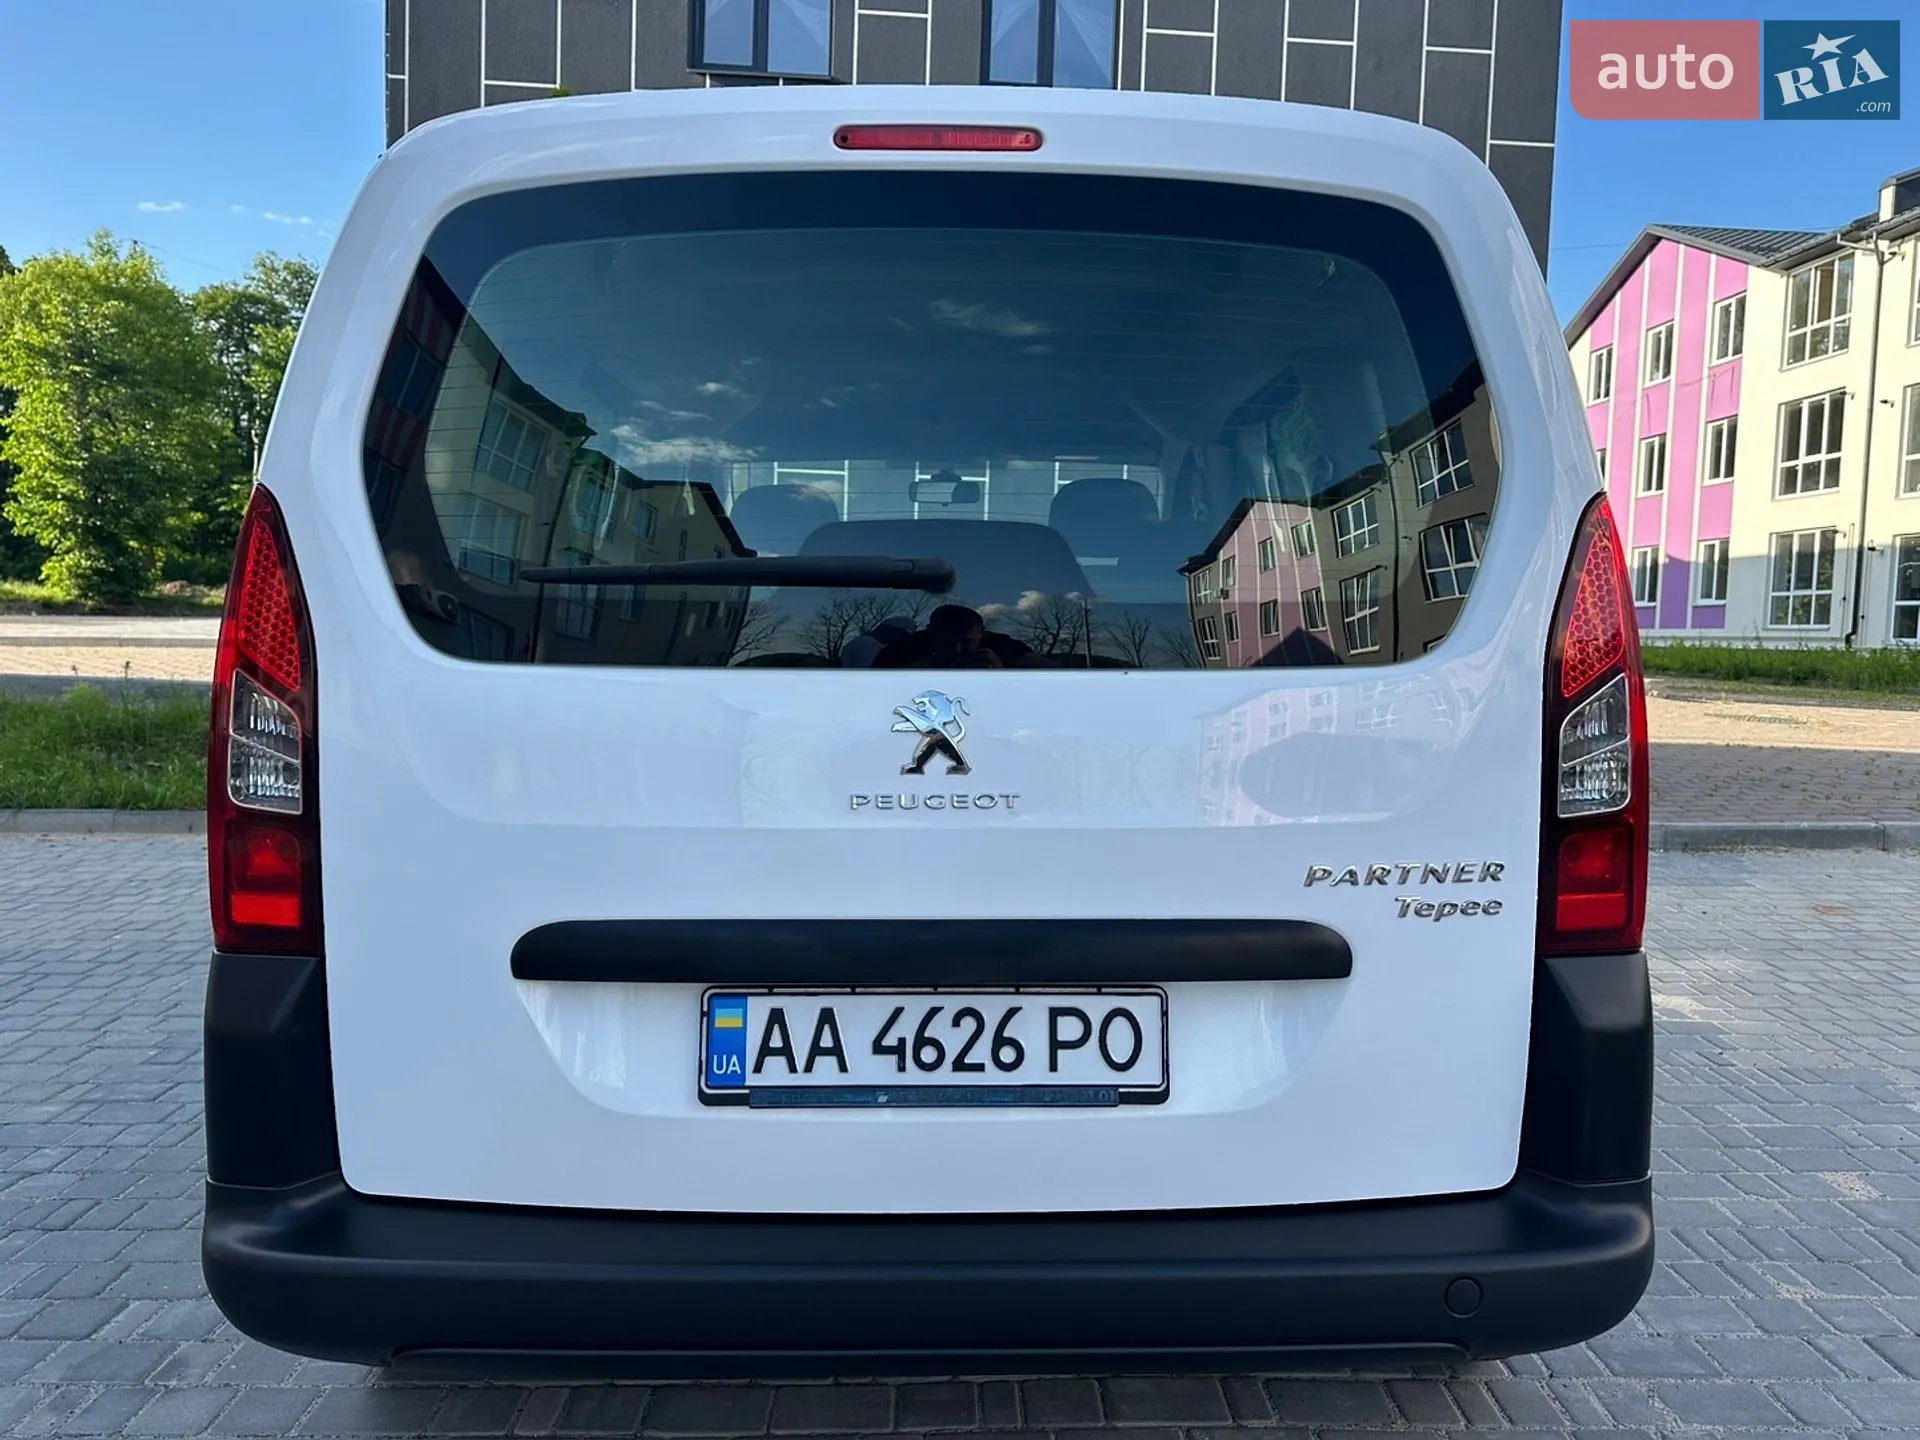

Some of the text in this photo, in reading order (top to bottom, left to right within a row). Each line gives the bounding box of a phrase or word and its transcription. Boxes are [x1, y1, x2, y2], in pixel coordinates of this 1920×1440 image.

[850, 793, 1020, 811] PEUGEOT
[1303, 861, 1505, 888] PARTNER
[1394, 895, 1503, 922] Tepee
[752, 1006, 1143, 1074] AA 4626 PO
[713, 1055, 742, 1075] UA
